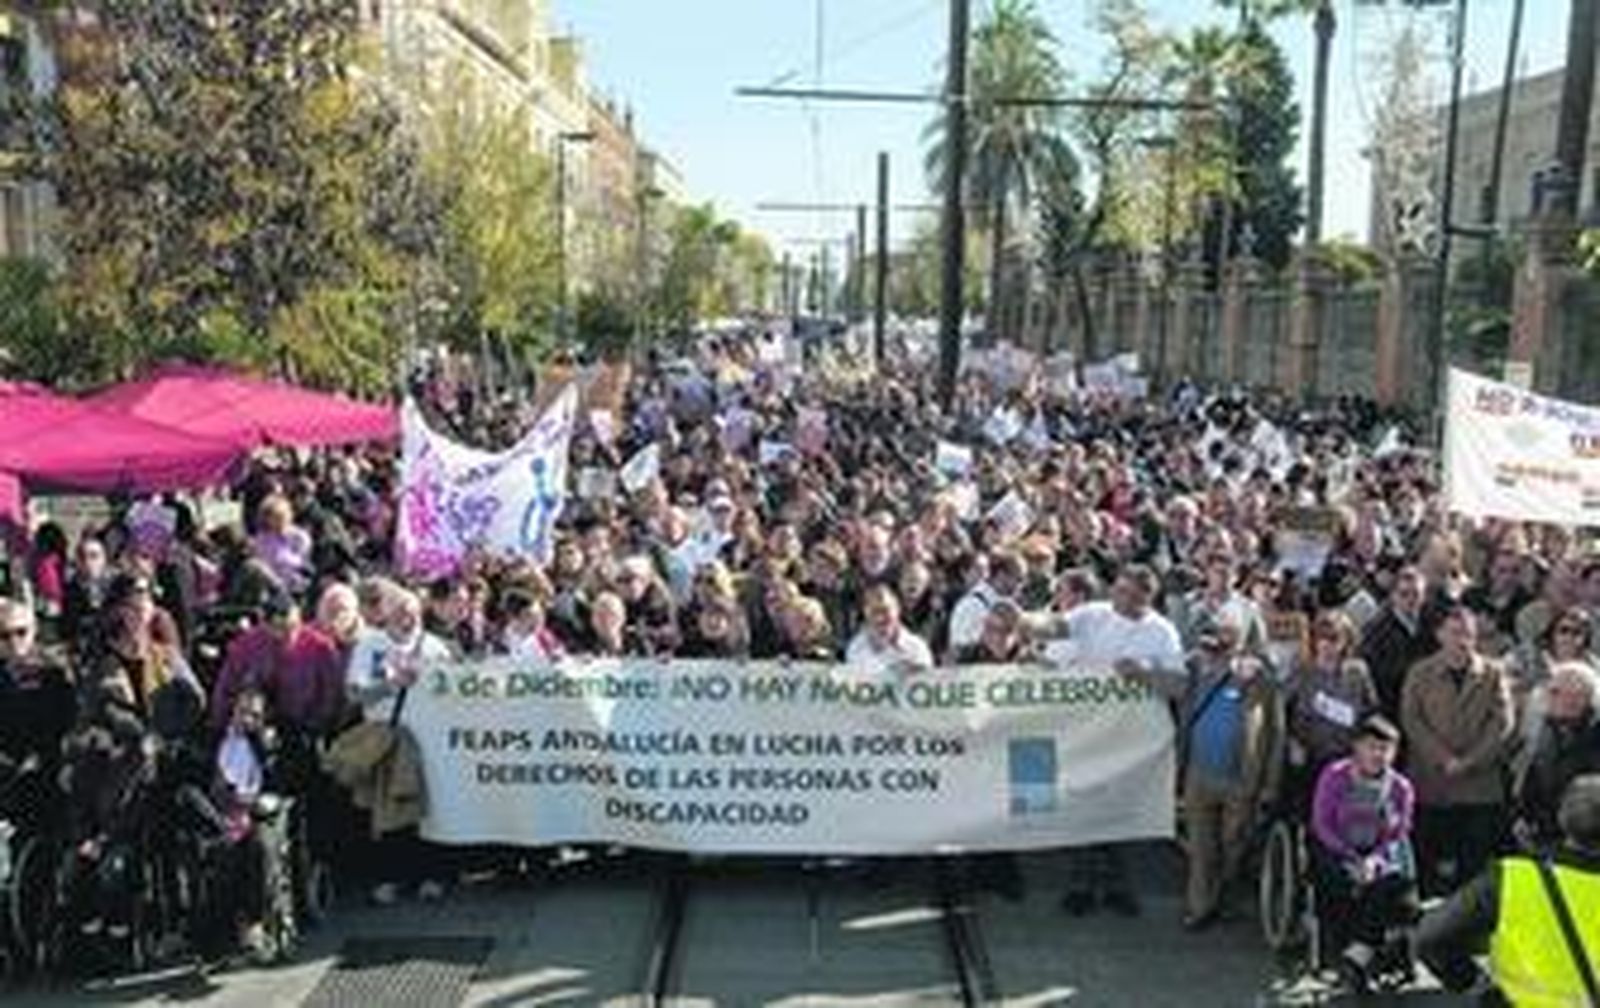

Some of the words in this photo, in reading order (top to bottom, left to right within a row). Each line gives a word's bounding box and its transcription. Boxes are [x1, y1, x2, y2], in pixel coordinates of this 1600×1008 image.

[458, 673, 497, 698] de
[741, 676, 799, 700] HAY
[808, 678, 897, 706] NADA
[906, 681, 976, 709] QUE
[448, 728, 532, 754] FEAPS
[541, 726, 700, 756] ANDALUCÍA
[708, 734, 747, 757] EN
[754, 732, 845, 758] LUCHA
[852, 735, 908, 758] POR
[477, 764, 617, 787] DERECHOS
[625, 768, 661, 790] DE
[668, 769, 721, 790] LAS
[728, 768, 872, 791] PERSONAS
[881, 769, 940, 793] CON
[605, 800, 810, 827] DISCAPACIDAD
